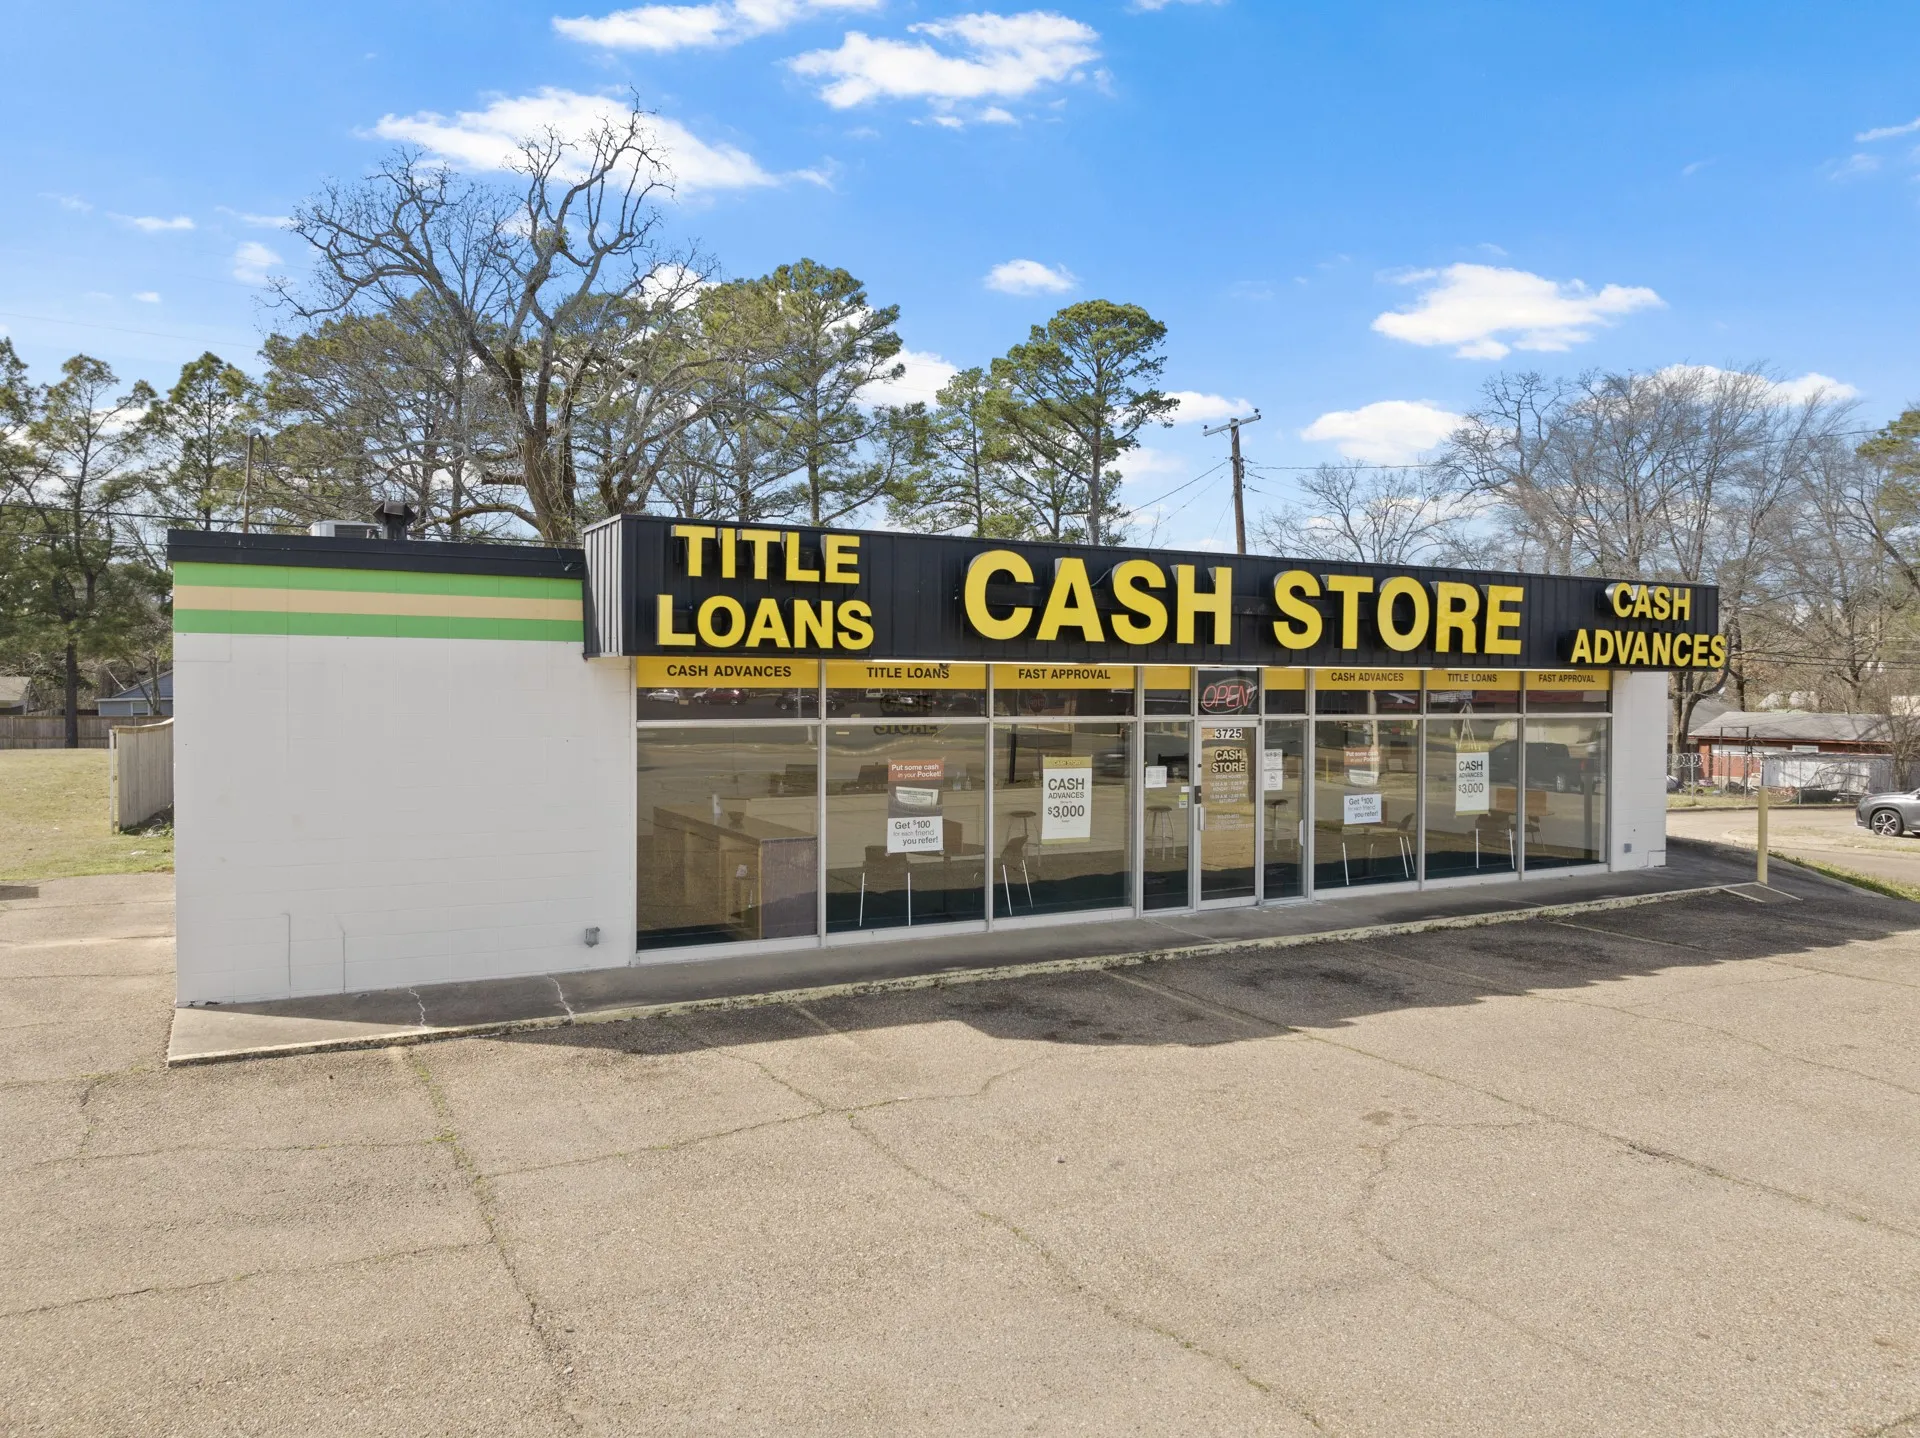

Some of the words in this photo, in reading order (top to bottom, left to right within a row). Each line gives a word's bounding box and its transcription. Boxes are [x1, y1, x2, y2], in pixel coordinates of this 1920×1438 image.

[673, 525, 860, 584] TITLE
[963, 550, 1232, 645] CASH
[1273, 570, 1525, 656] STORE
[1611, 582, 1691, 620] CASH
[656, 594, 874, 650] LOANS
[1570, 628, 1727, 668] ADVANCES
[666, 664, 708, 677] CASH
[713, 665, 792, 678] ADVANCES
[866, 667, 902, 679] TITLE
[907, 667, 950, 680] LOANS
[1018, 668, 1047, 680] FAST
[1050, 668, 1111, 681] APPROVAL
[1331, 672, 1356, 682] CASH
[1358, 672, 1404, 683] ADVANCES
[1447, 673, 1469, 683] TITLE
[1472, 673, 1497, 683] LOANS
[1538, 674, 1557, 683] FAST
[1558, 674, 1595, 684] APPROVAL
[1203, 685, 1250, 707] OPEN
[1215, 728, 1242, 739] 3725
[1214, 749, 1243, 761] CASH
[923, 763, 939, 771] cash
[1211, 762, 1246, 773] STORE
[1458, 760, 1483, 771] CASH
[917, 770, 942, 778] Pocket!
[1048, 778, 1085, 791] CASH
[1458, 783, 1484, 795] $3,000
[1048, 791, 1085, 799] ADVANCES
[1360, 796, 1373, 805] $100
[1047, 805, 1085, 818] $3,000
[894, 821, 911, 830] Get
[912, 820, 931, 829] $100
[902, 838, 917, 847] you
[917, 836, 938, 844] refer!
